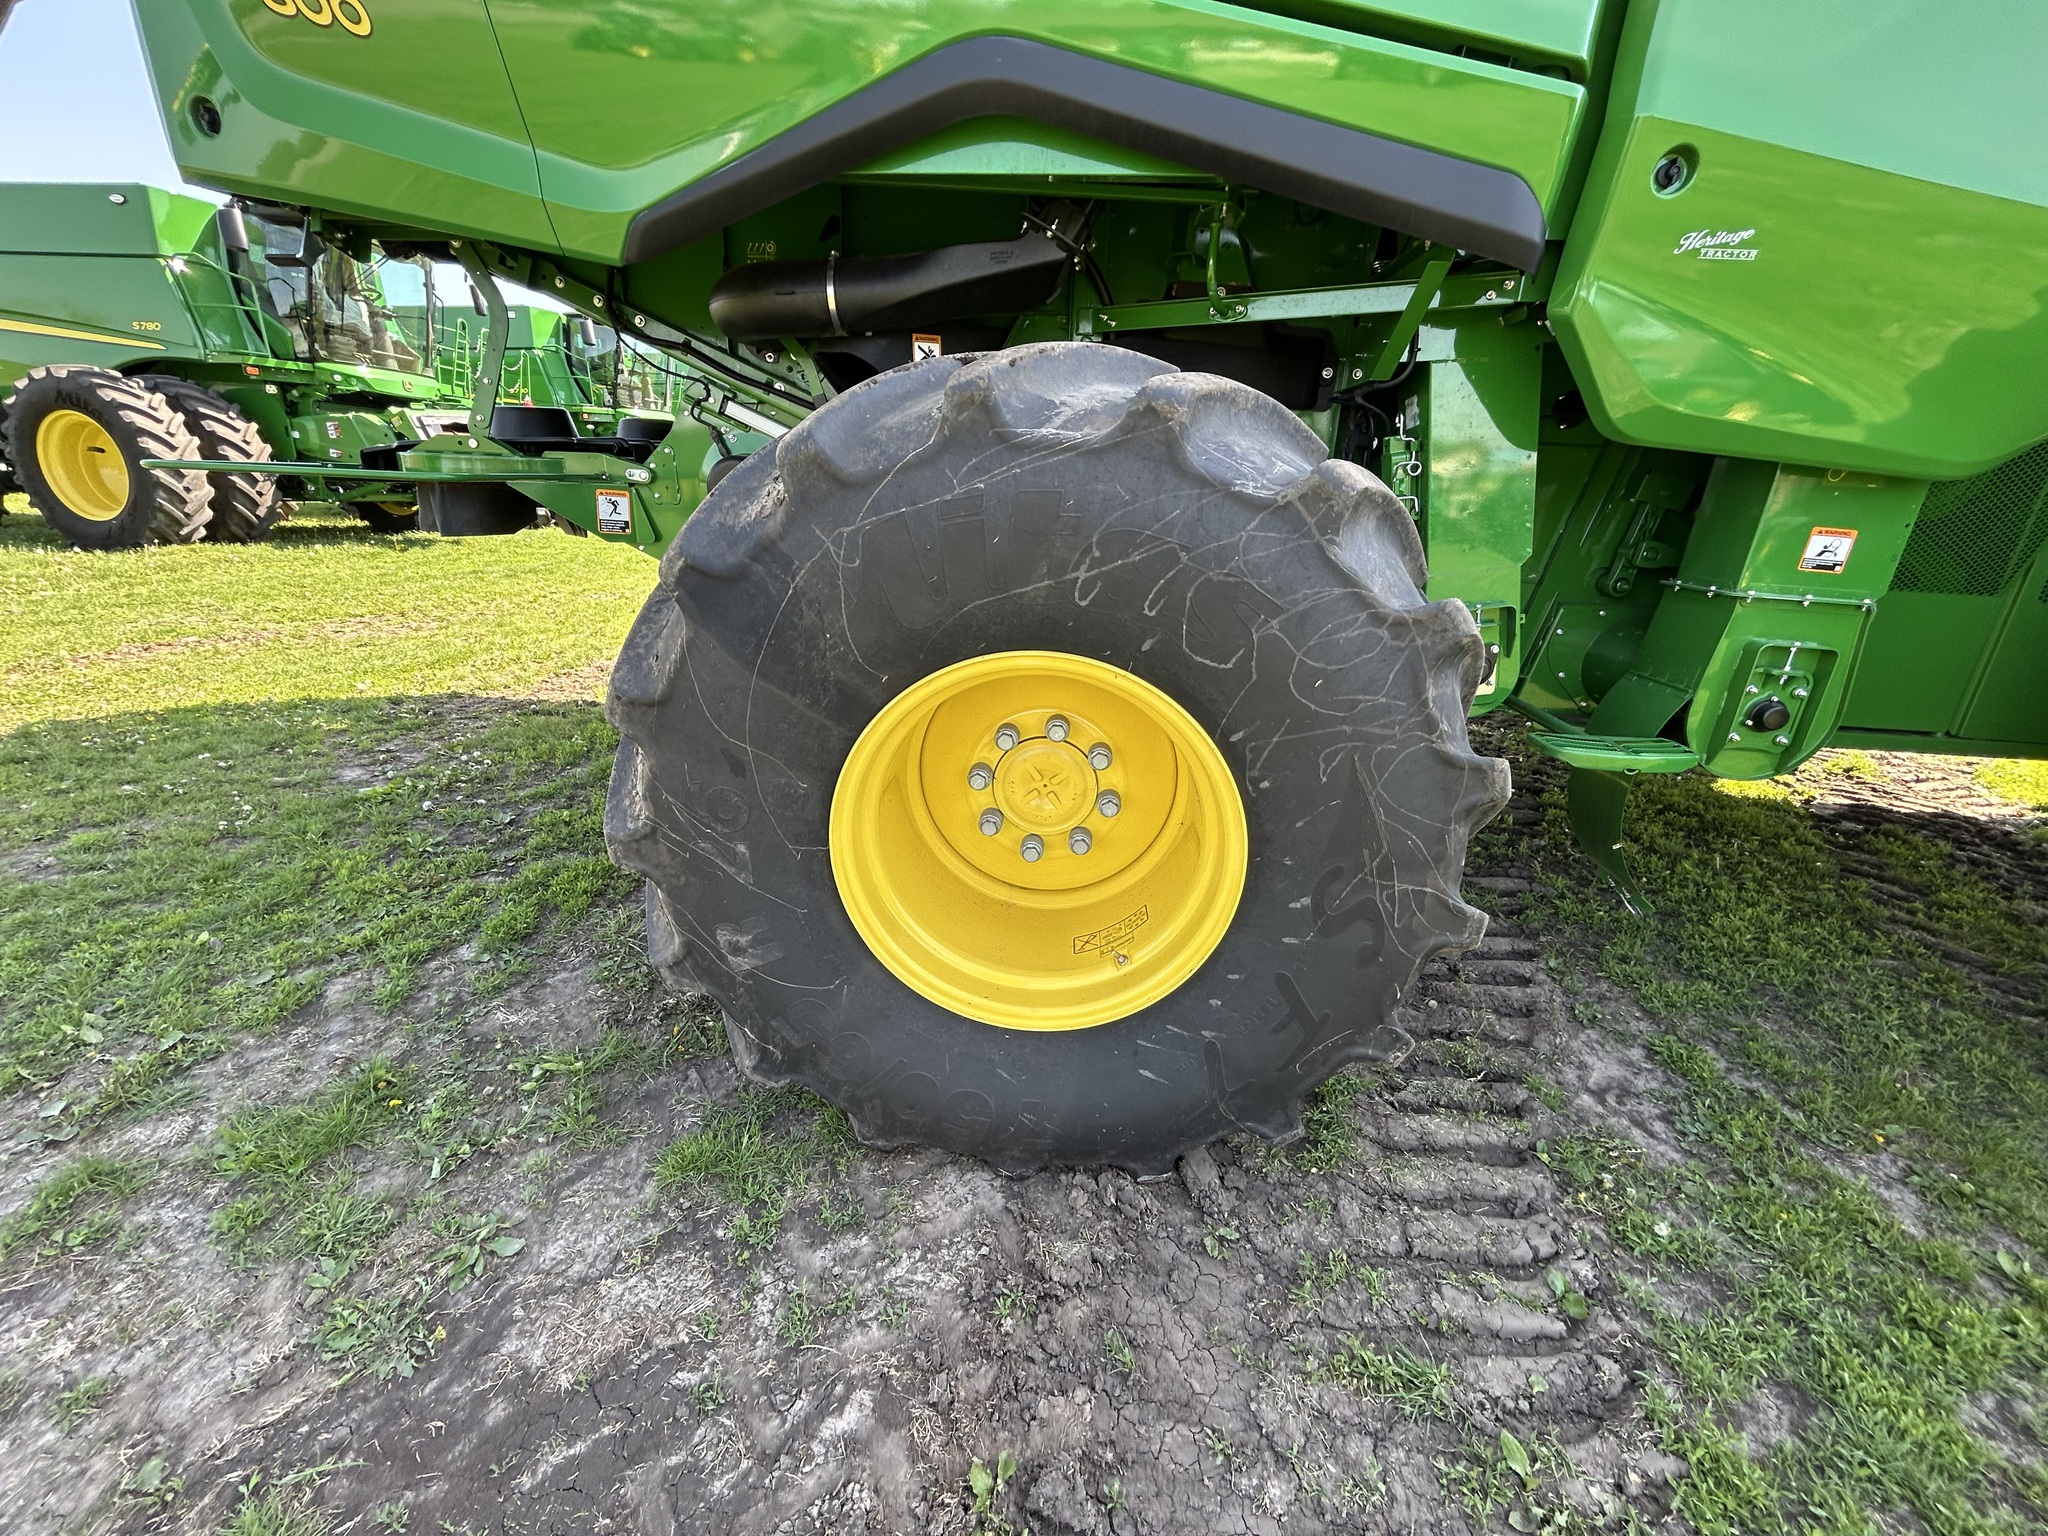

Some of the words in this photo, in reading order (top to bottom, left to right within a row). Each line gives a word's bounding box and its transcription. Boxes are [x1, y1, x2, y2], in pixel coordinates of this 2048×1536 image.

[1673, 229, 1756, 254] Heritage
[1699, 250, 1757, 259] TRACTOR
[132, 321, 162, 332] S780
[1824, 529, 1852, 537] WARNING
